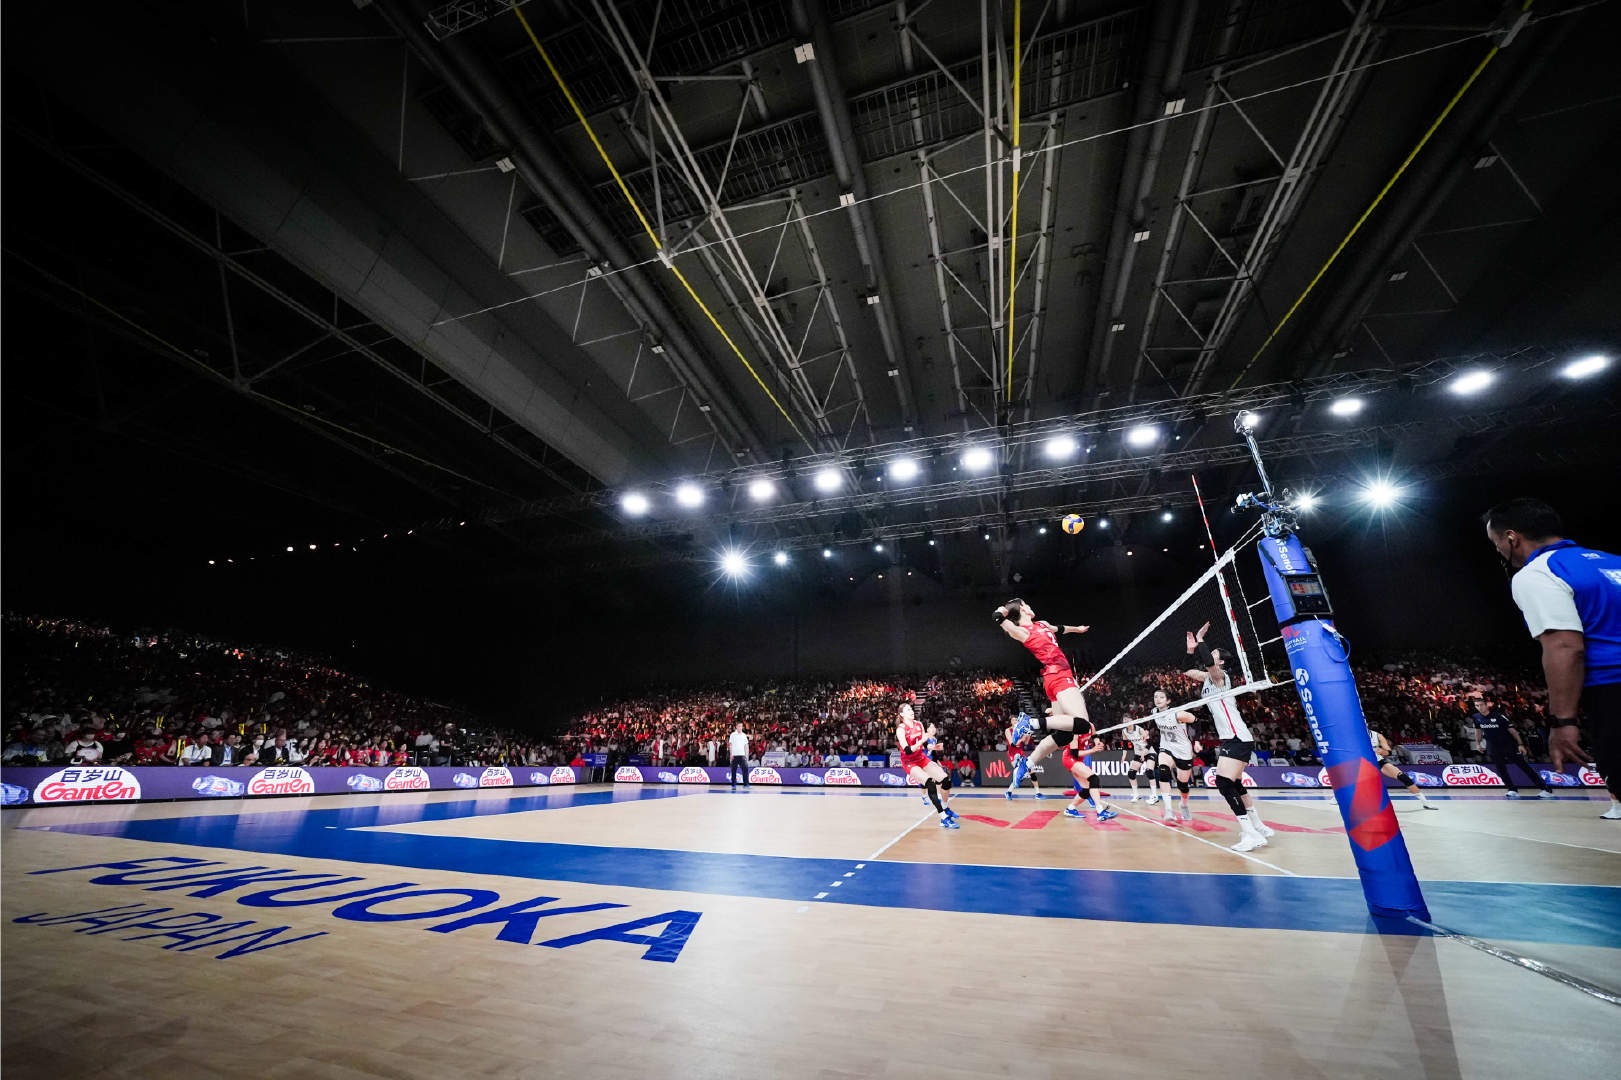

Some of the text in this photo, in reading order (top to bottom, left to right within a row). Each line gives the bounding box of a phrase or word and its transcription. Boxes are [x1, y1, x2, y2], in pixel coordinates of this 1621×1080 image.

[1300, 687, 1330, 754] Senoh
[60, 769, 123, 783] 百岁山
[263, 769, 303, 780] 百岁山
[1091, 761, 1148, 776] UKUOA
[251, 778, 311, 794] Ganten
[1446, 773, 1501, 785] Ganten
[40, 781, 136, 801] Ganten
[24, 856, 703, 963] FUKUOKA
[11, 903, 330, 960] JAPAN
